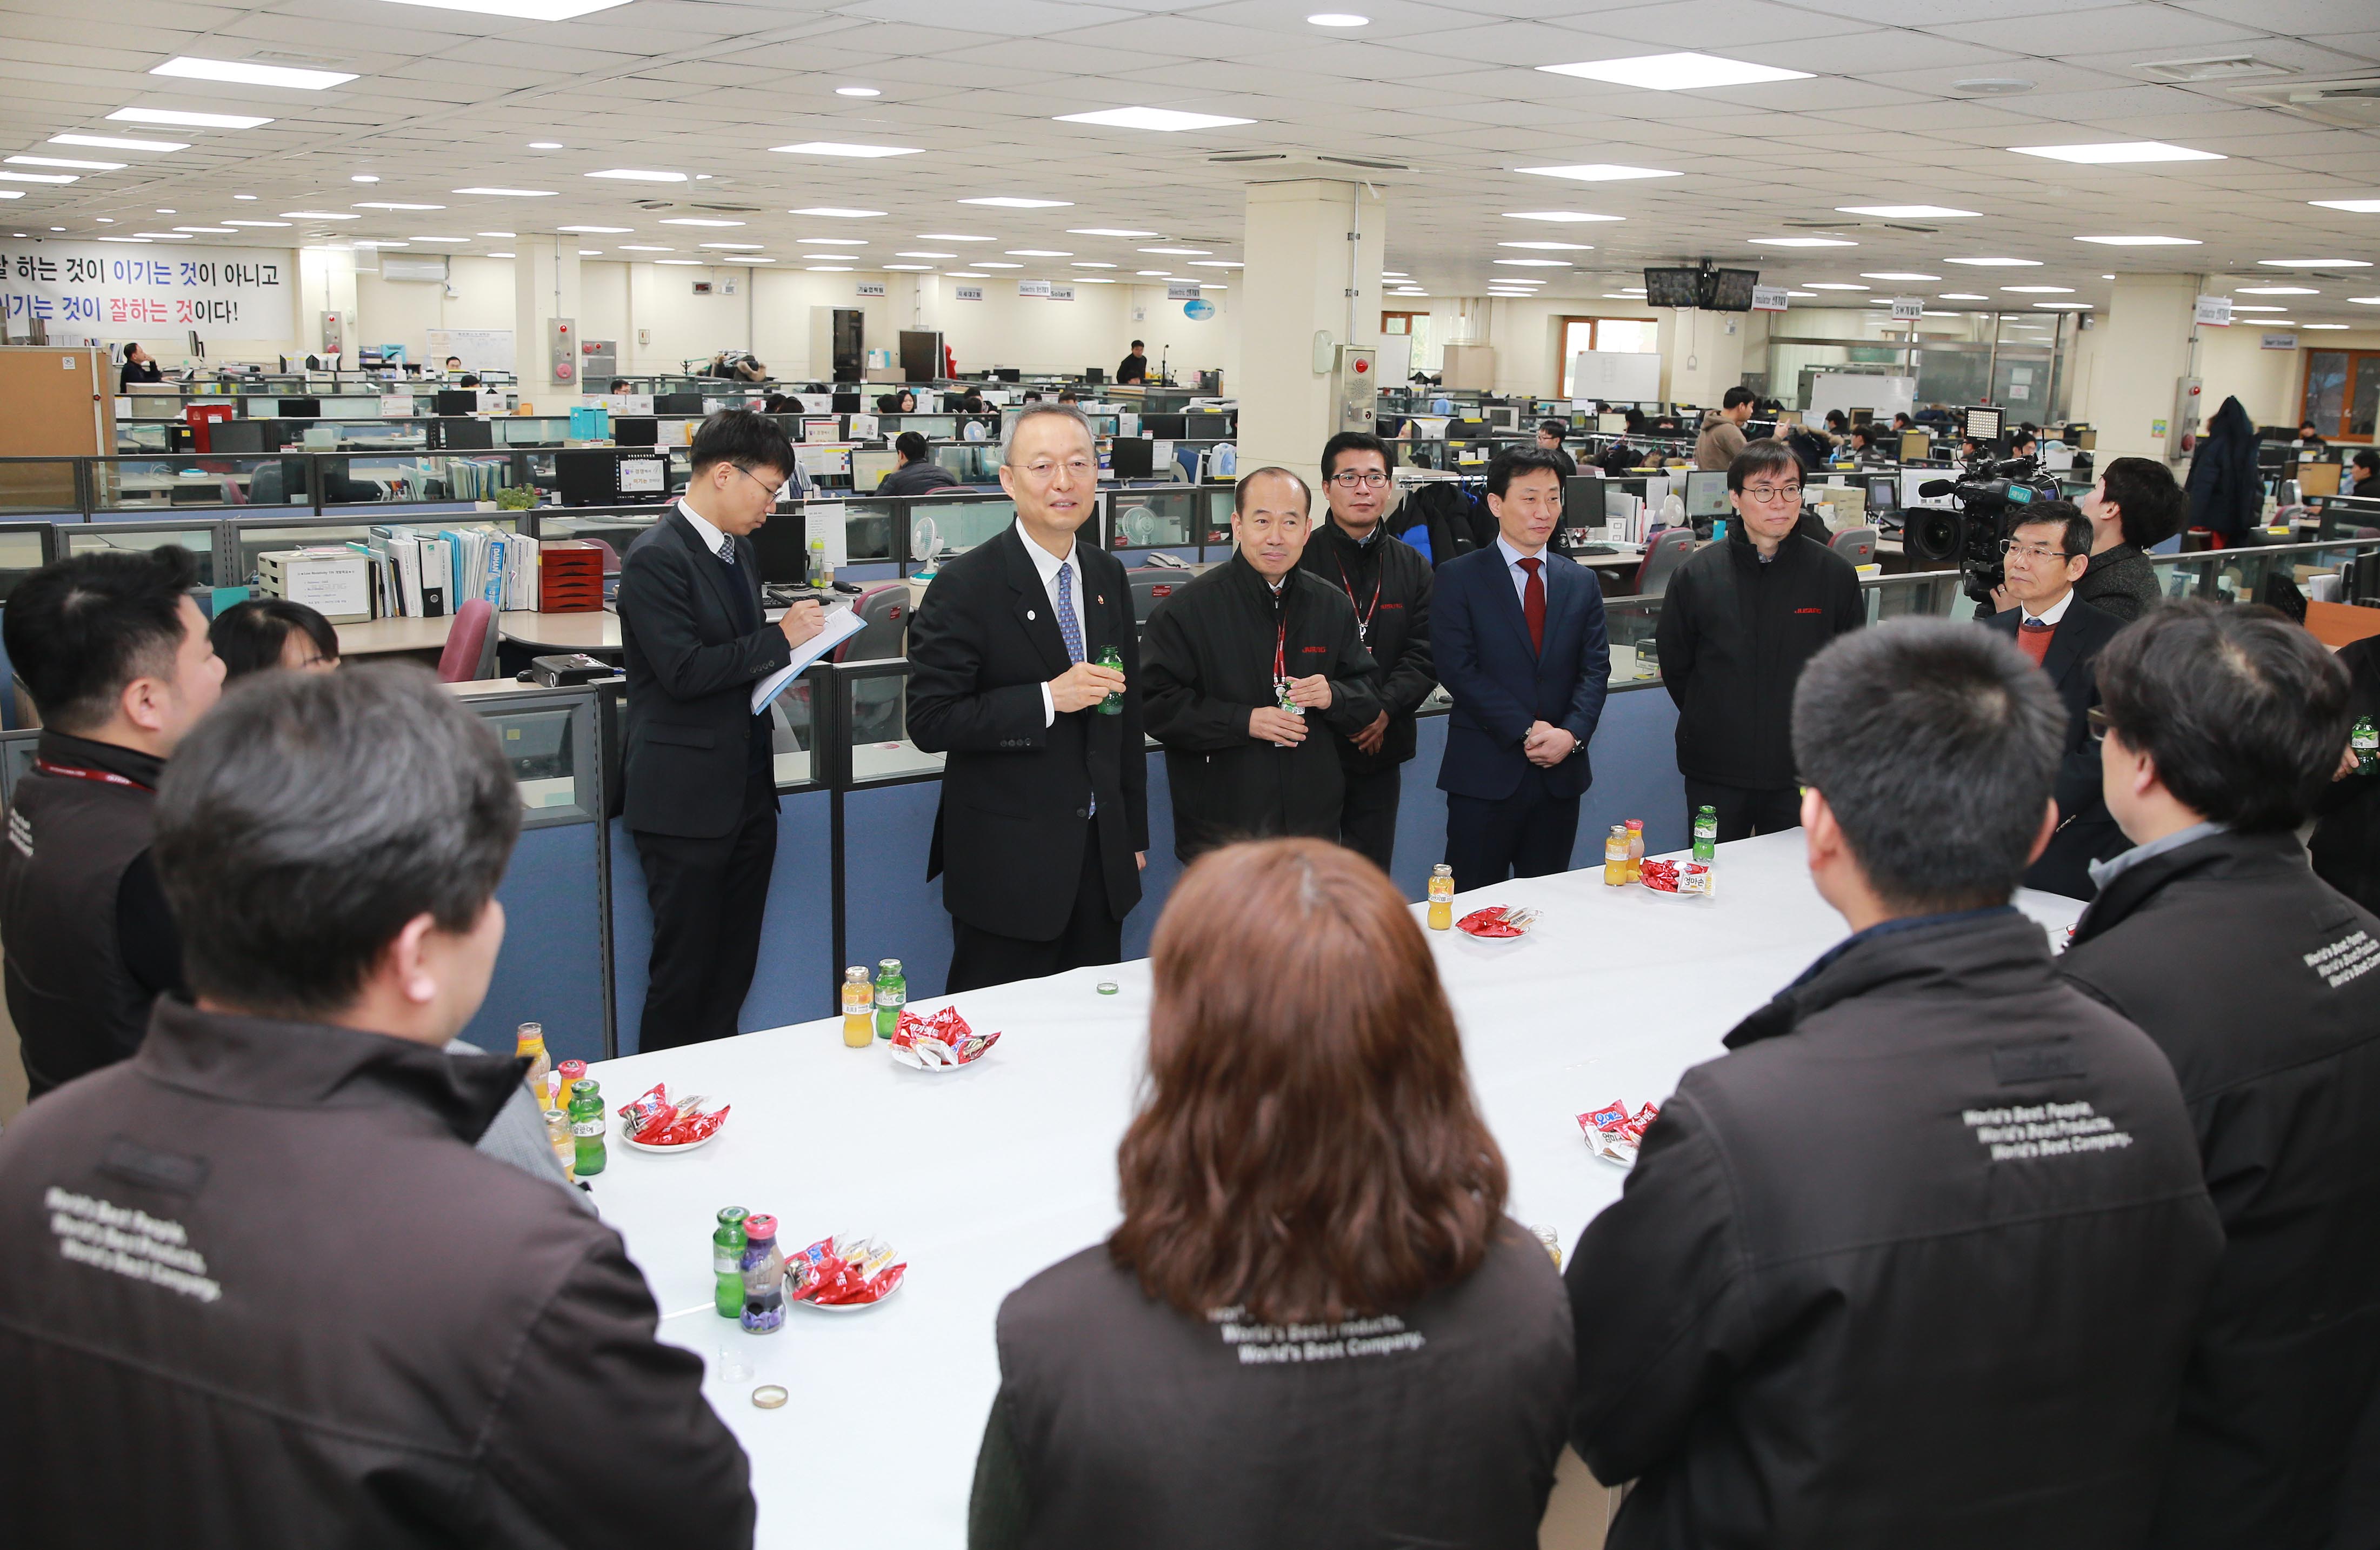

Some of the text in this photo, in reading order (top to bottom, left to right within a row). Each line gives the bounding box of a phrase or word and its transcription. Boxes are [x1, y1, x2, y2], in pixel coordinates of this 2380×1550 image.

[17, 256, 57, 282] 하는
[66, 258, 105, 284] 것이
[114, 260, 171, 285] 이기는
[181, 262, 216, 286] 것이
[225, 263, 279, 286] 아니고
[62, 296, 101, 322] 것이
[110, 298, 168, 323] 잘하는
[176, 299, 238, 324] 것이다!
[1684, 877, 1704, 886] 엄마손
[2330, 939, 2350, 956] Best
[1596, 1111, 1624, 1128] 오예스
[2011, 1105, 2046, 1123] Best
[2045, 1100, 2095, 1120] People.
[573, 1126, 594, 1134] 알로에
[2025, 1122, 2057, 1140] Best
[2056, 1116, 2115, 1136] Products.
[2038, 1138, 2071, 1156] Best
[2071, 1132, 2134, 1153] Company.
[97, 1199, 133, 1230] Best
[105, 1225, 143, 1254] Best
[115, 1252, 151, 1280] Best
[1303, 1340, 1346, 1361] Best
[1346, 1331, 1426, 1356] Company.
